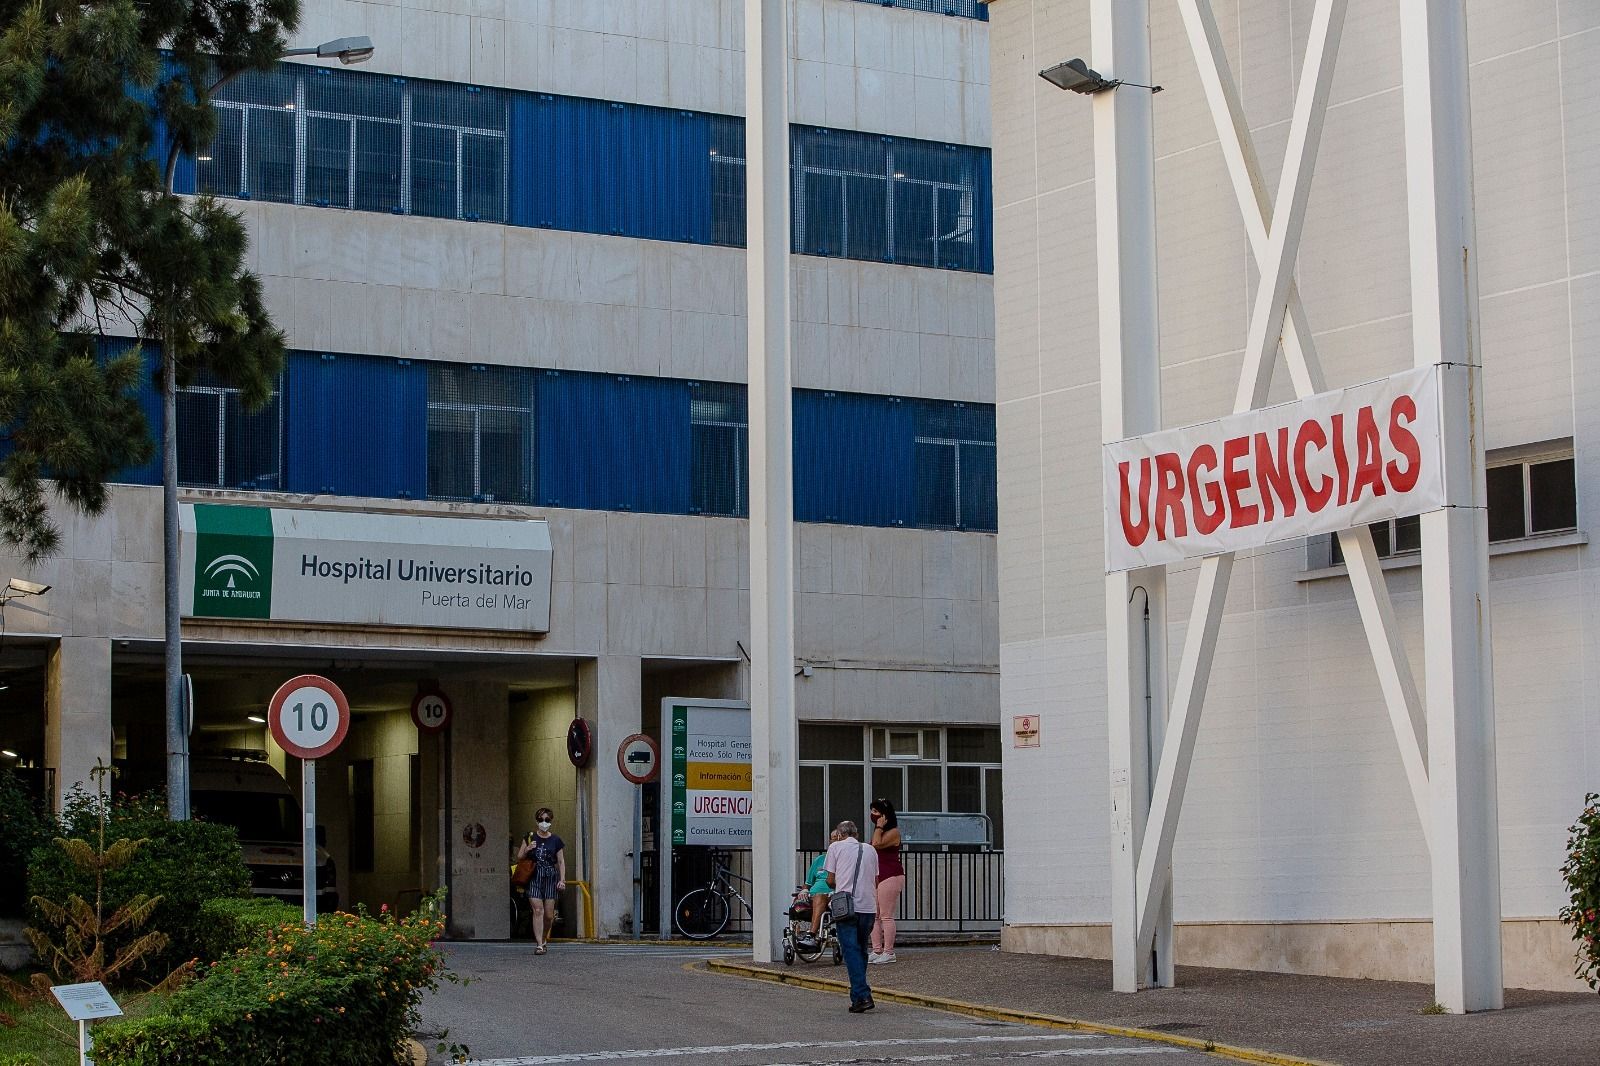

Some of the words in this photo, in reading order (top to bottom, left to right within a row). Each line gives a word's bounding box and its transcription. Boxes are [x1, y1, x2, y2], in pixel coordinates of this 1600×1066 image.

[1118, 394, 1421, 547] URGENCIAS
[301, 554, 391, 584] Hospital
[398, 559, 533, 587] Universitario
[202, 588, 220, 597] JUNTA
[222, 589, 230, 598] DE
[422, 590, 470, 608] Puerta
[476, 593, 497, 609] del
[503, 594, 532, 610] Mar
[292, 702, 328, 732] 10
[425, 703, 443, 718] 10
[697, 739, 727, 750] Hospital
[730, 740, 752, 749] Gener
[689, 750, 714, 758] Acceso
[736, 751, 752, 759] Pers
[699, 771, 742, 781] Información
[690, 826, 726, 836] Consultas
[728, 827, 752, 836] Extern
